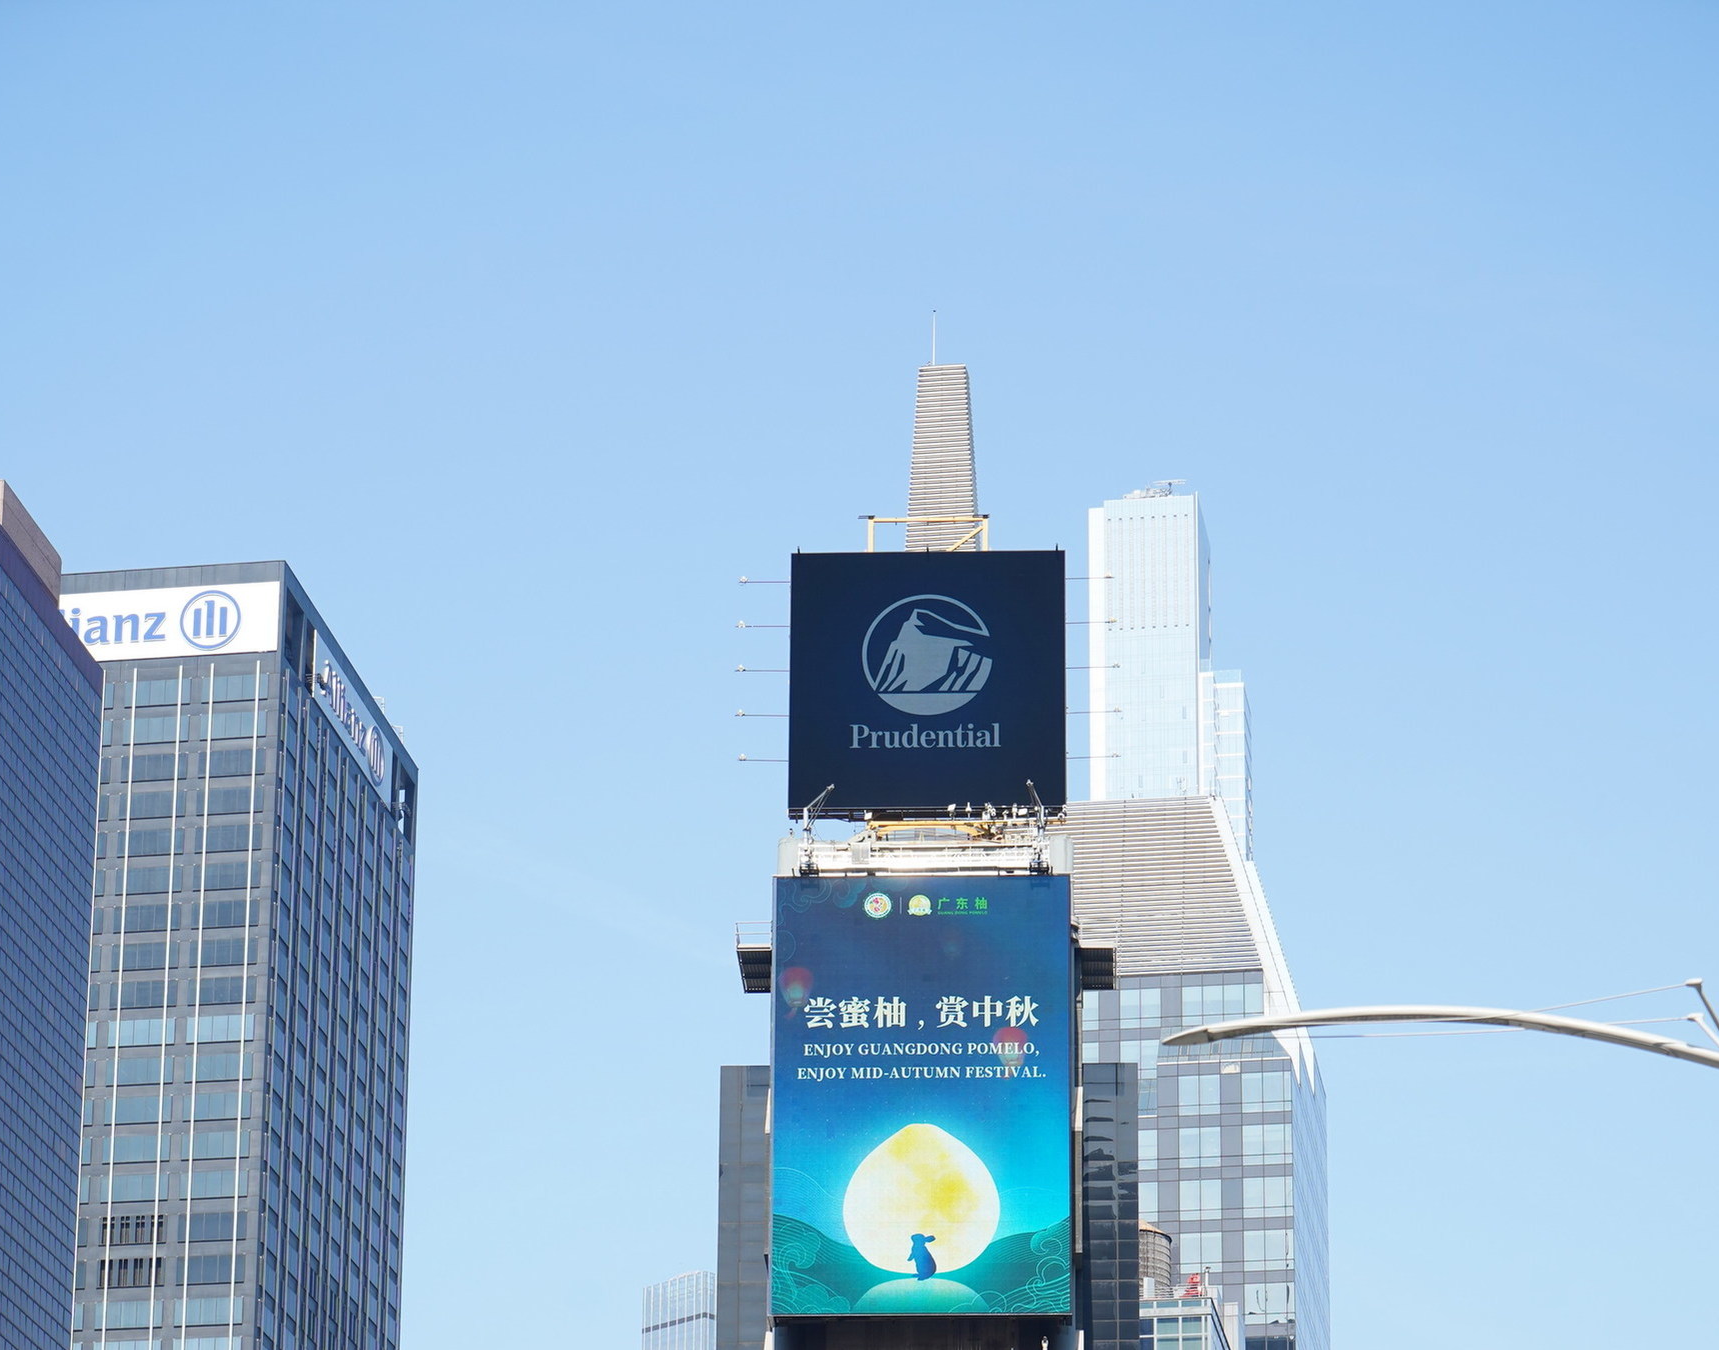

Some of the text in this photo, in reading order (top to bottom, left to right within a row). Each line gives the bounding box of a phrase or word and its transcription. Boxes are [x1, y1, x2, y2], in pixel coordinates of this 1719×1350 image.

[60, 607, 166, 646] ianz
[849, 722, 1002, 749] Prudential
[937, 897, 988, 910] 广东柚
[803, 1042, 1040, 1059] ENJOY GUANGDONG POMELO,
[797, 1066, 1047, 1082] ENJOY MID-AUTUMN FESTIVAL.
